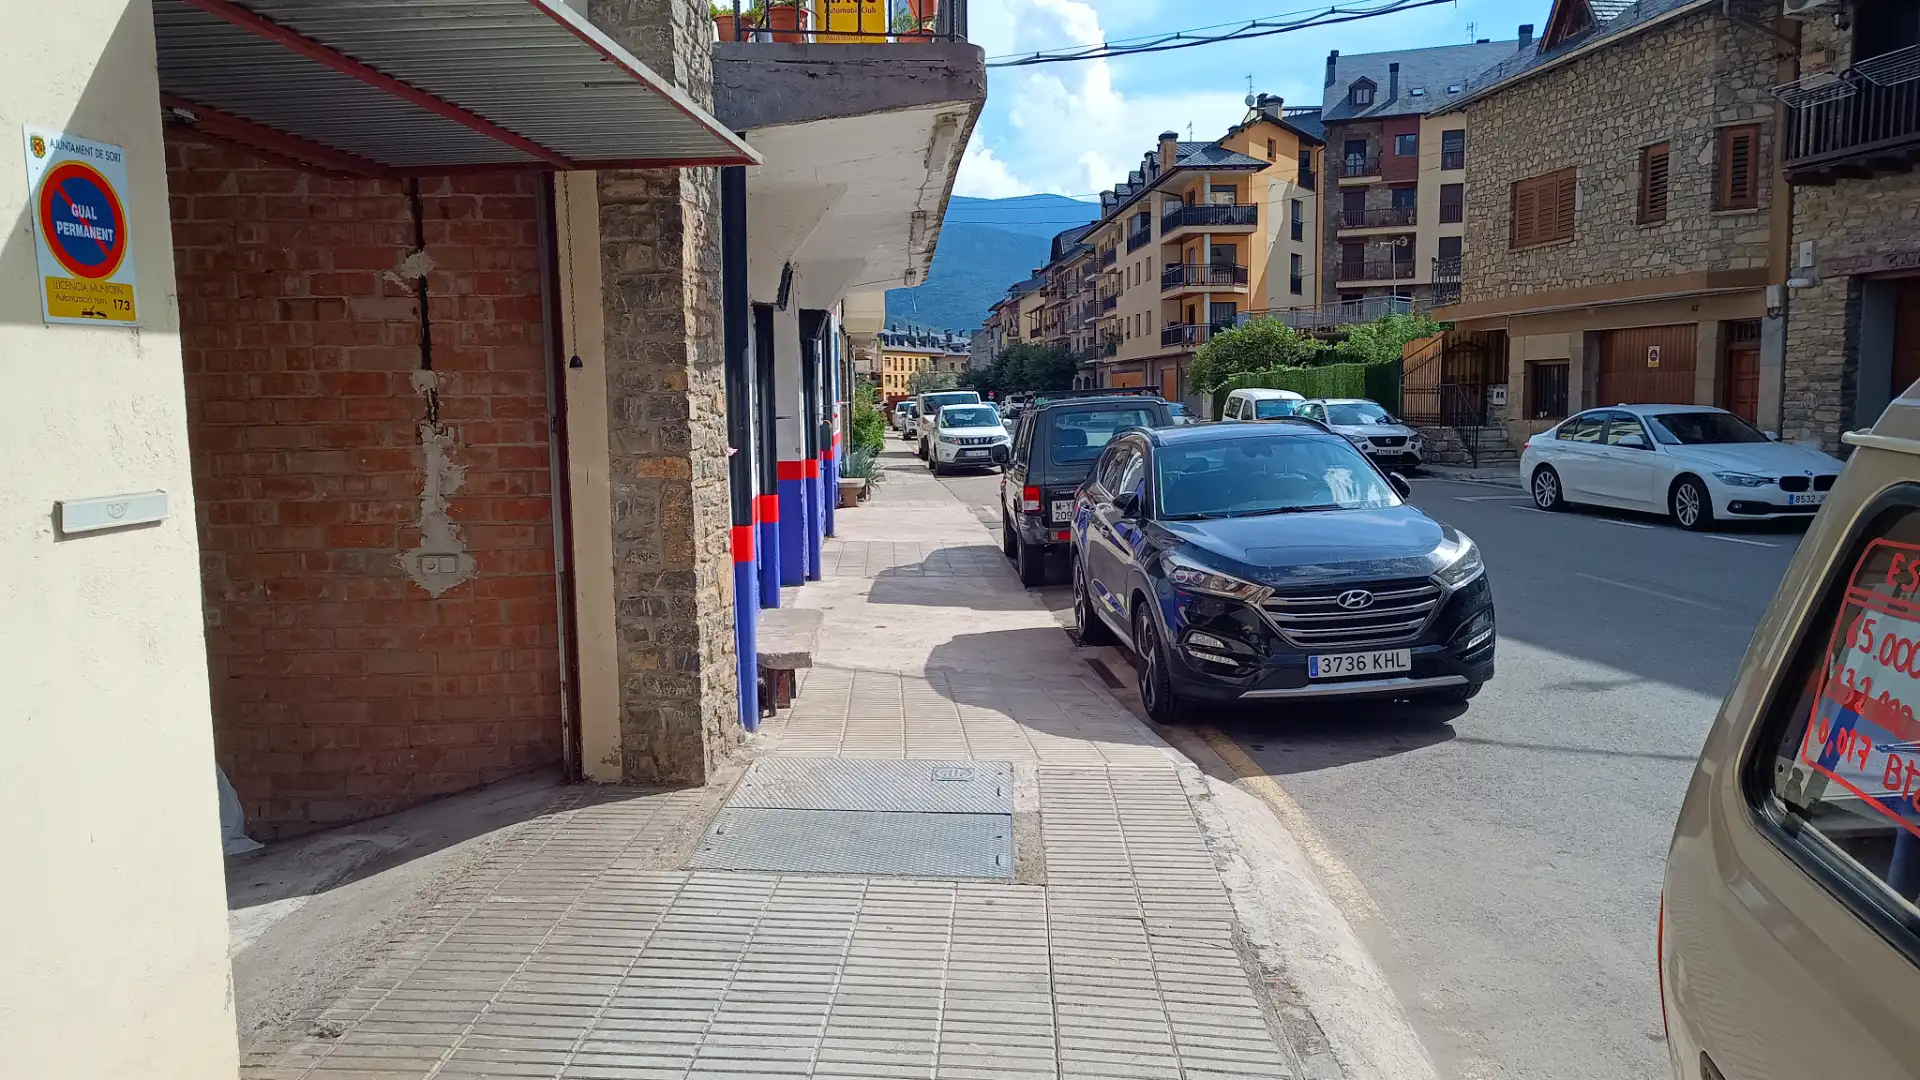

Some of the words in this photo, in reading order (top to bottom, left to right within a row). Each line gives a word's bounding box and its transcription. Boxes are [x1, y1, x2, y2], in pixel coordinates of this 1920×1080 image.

[862, 5, 876, 14] Club
[50, 138, 94, 157] AJUNTAMENT
[95, 148, 103, 159] DE
[105, 151, 121, 162] SORT
[71, 203, 98, 220] GUAL
[56, 220, 114, 242] PERMANENT
[112, 298, 131, 310] 173
[1055, 501, 1075, 511] M-Y
[1795, 494, 1816, 504] 8532
[1321, 654, 1367, 674] 3736
[1373, 651, 1406, 670] KHL
